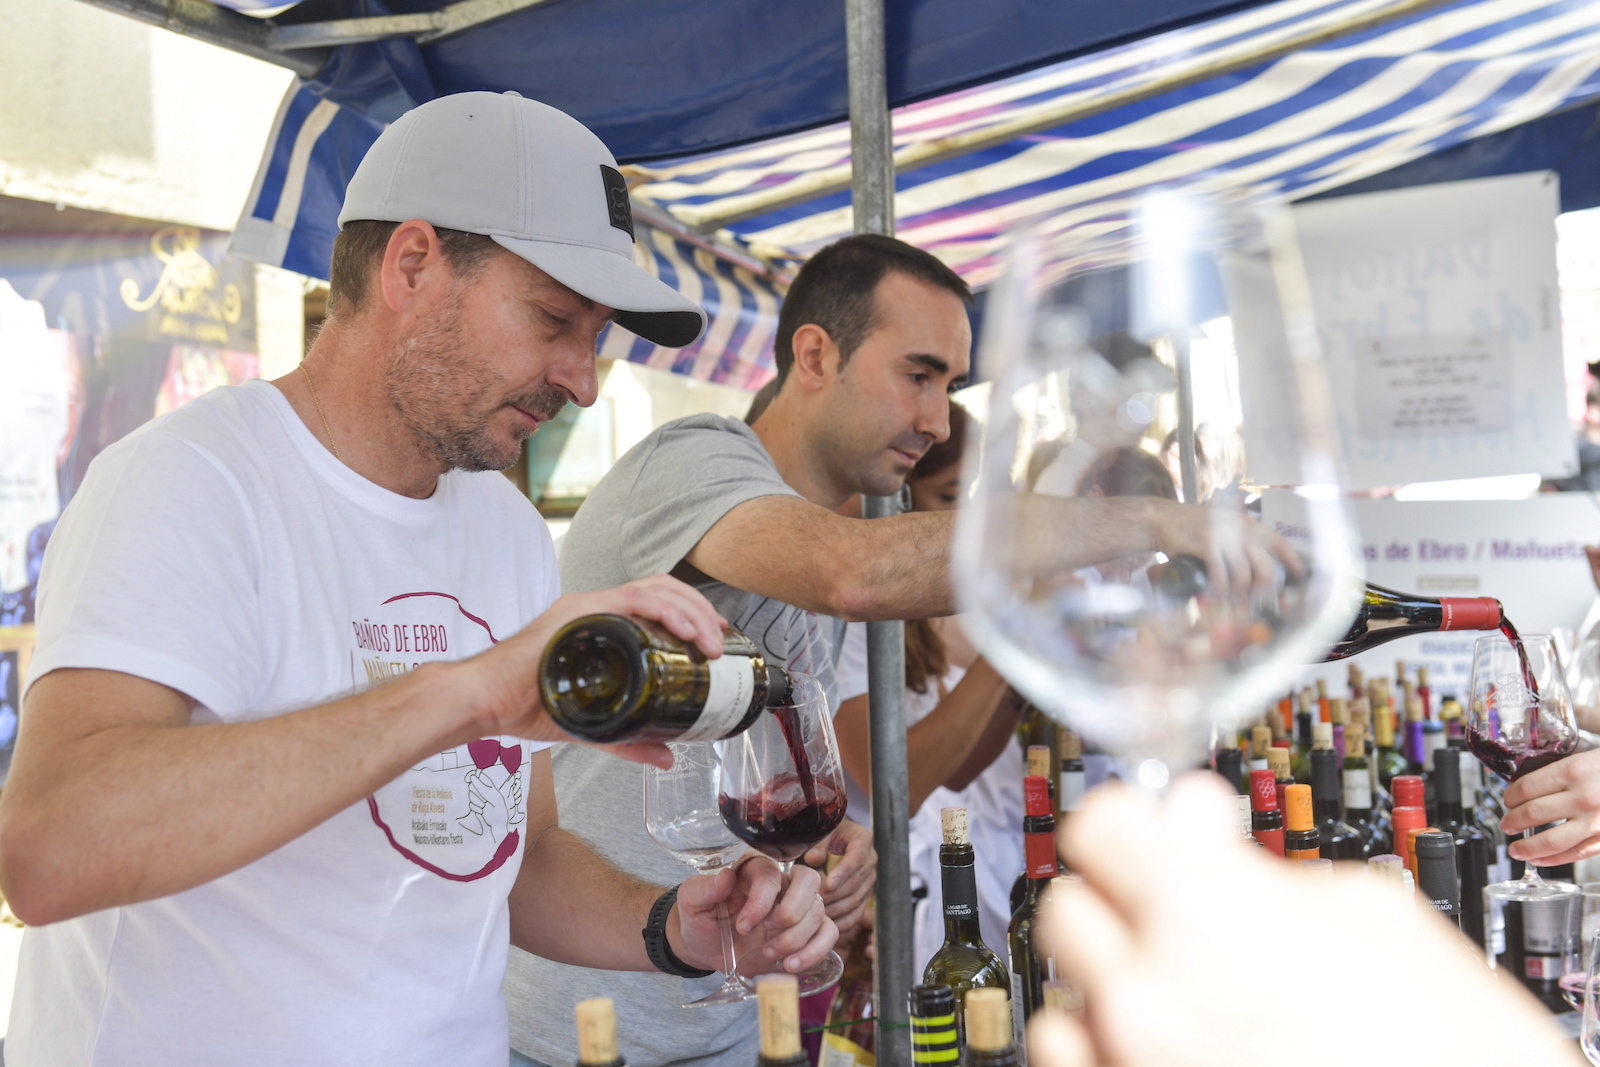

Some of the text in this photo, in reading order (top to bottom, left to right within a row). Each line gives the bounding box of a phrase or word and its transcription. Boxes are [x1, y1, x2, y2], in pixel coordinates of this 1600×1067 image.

[1385, 542, 1410, 562] de
[1417, 540, 1467, 562] Ebro
[352, 618, 448, 653] BAÑOS DE EBRO
